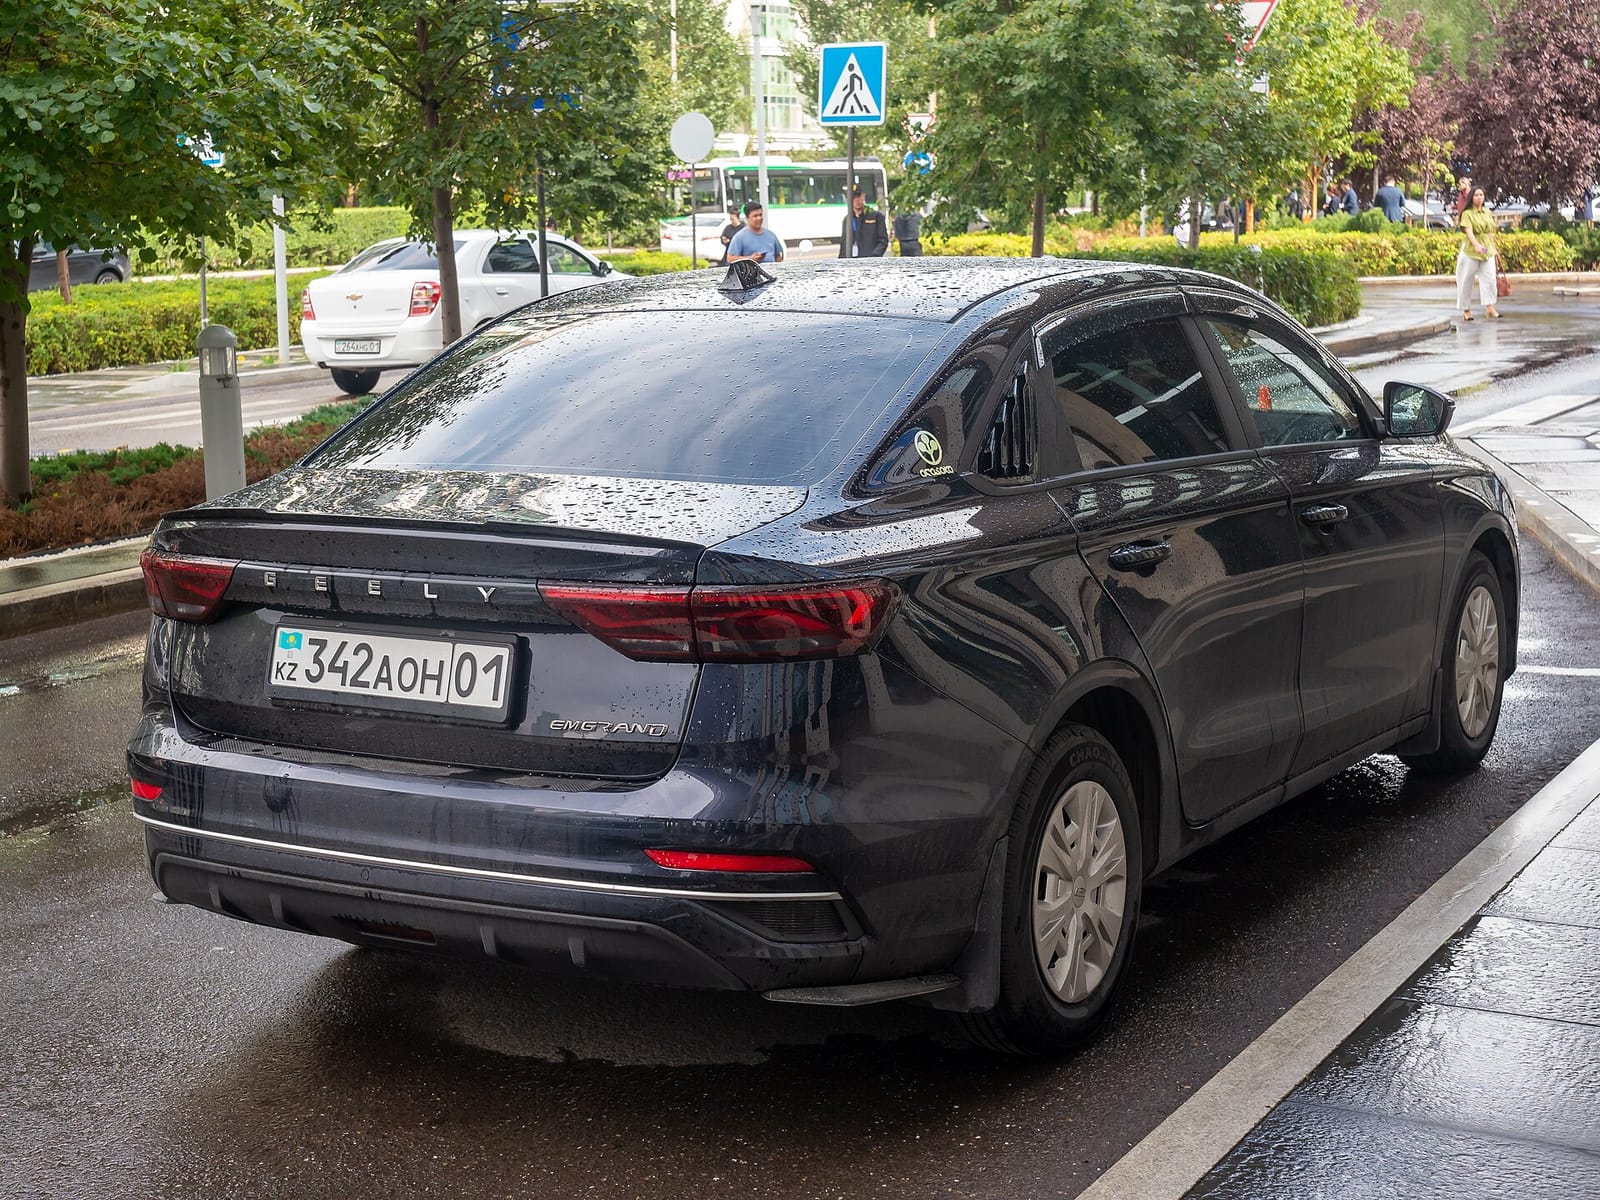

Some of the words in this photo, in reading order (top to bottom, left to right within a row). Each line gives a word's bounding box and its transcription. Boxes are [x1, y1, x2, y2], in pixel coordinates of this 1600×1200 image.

[264, 571, 496, 603] GEELY
[275, 661, 298, 681] KZ
[454, 651, 504, 701] 01
[549, 719, 669, 737] EMGRAND
